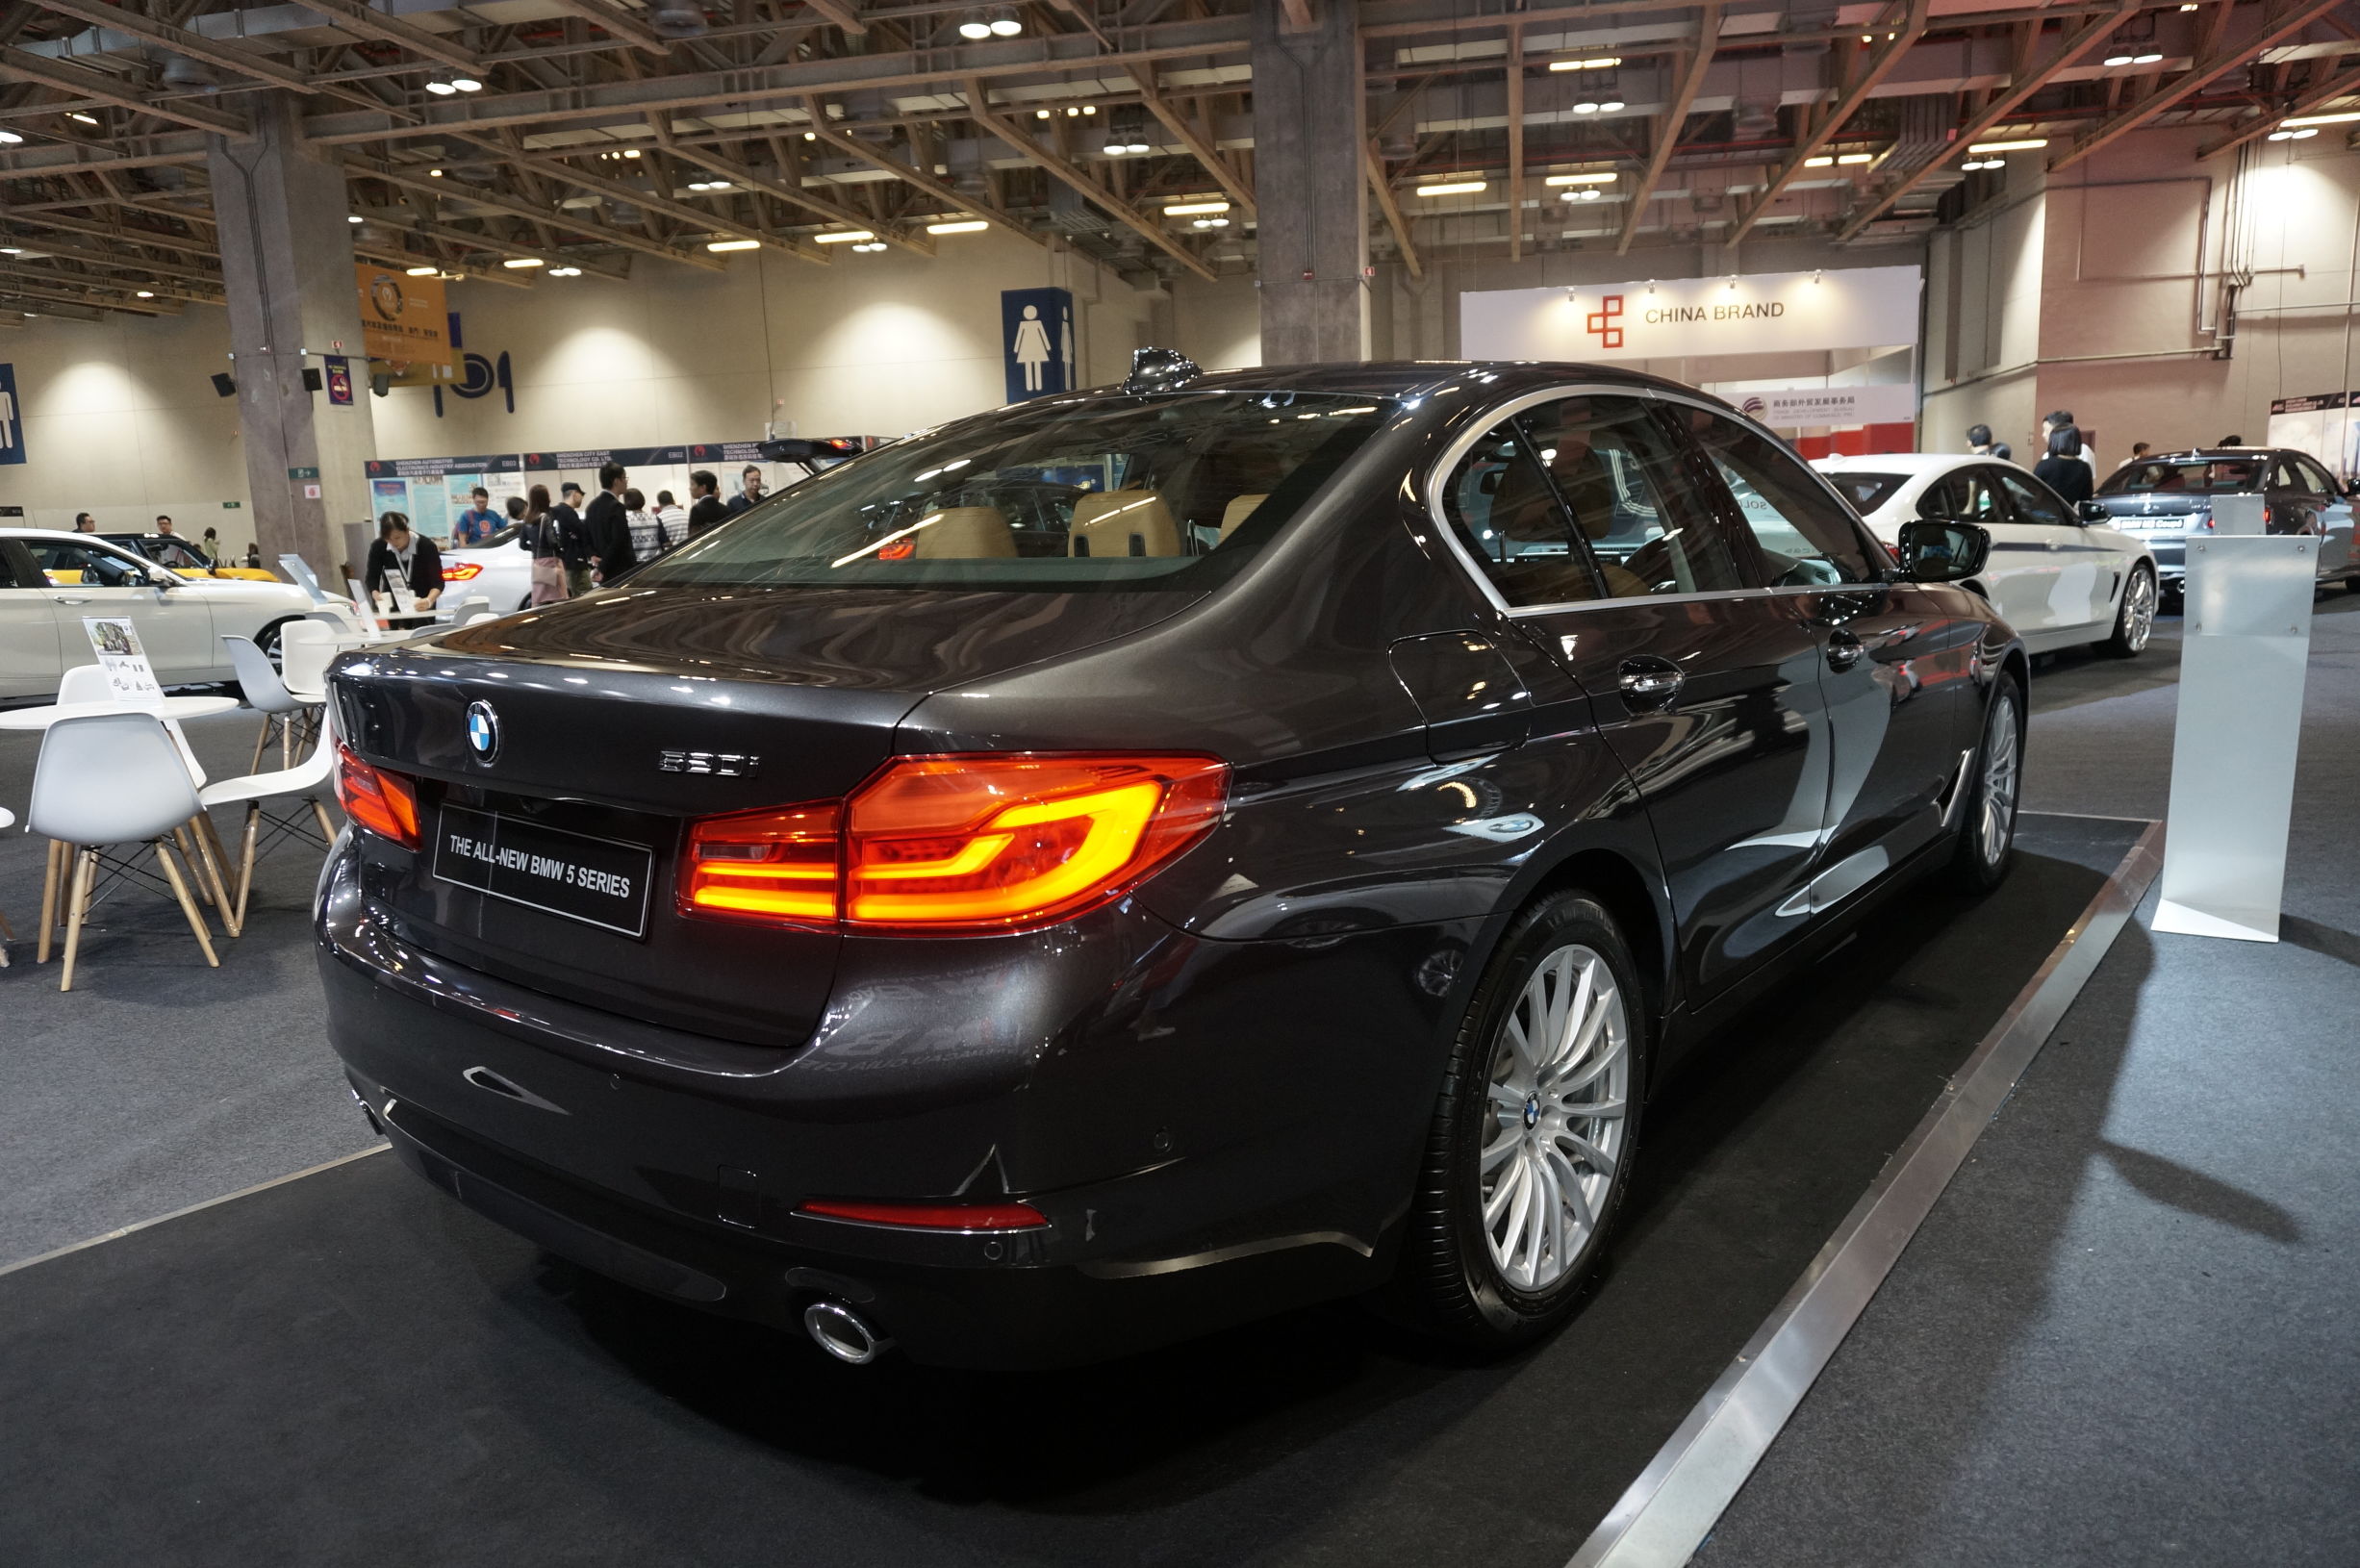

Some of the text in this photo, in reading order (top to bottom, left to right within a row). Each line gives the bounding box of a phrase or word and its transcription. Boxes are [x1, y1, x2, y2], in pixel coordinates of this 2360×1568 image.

[1645, 302, 1785, 324] CHINA BRAND
[449, 834, 630, 898] THE ALL-NEW BMW 5 SERIES
